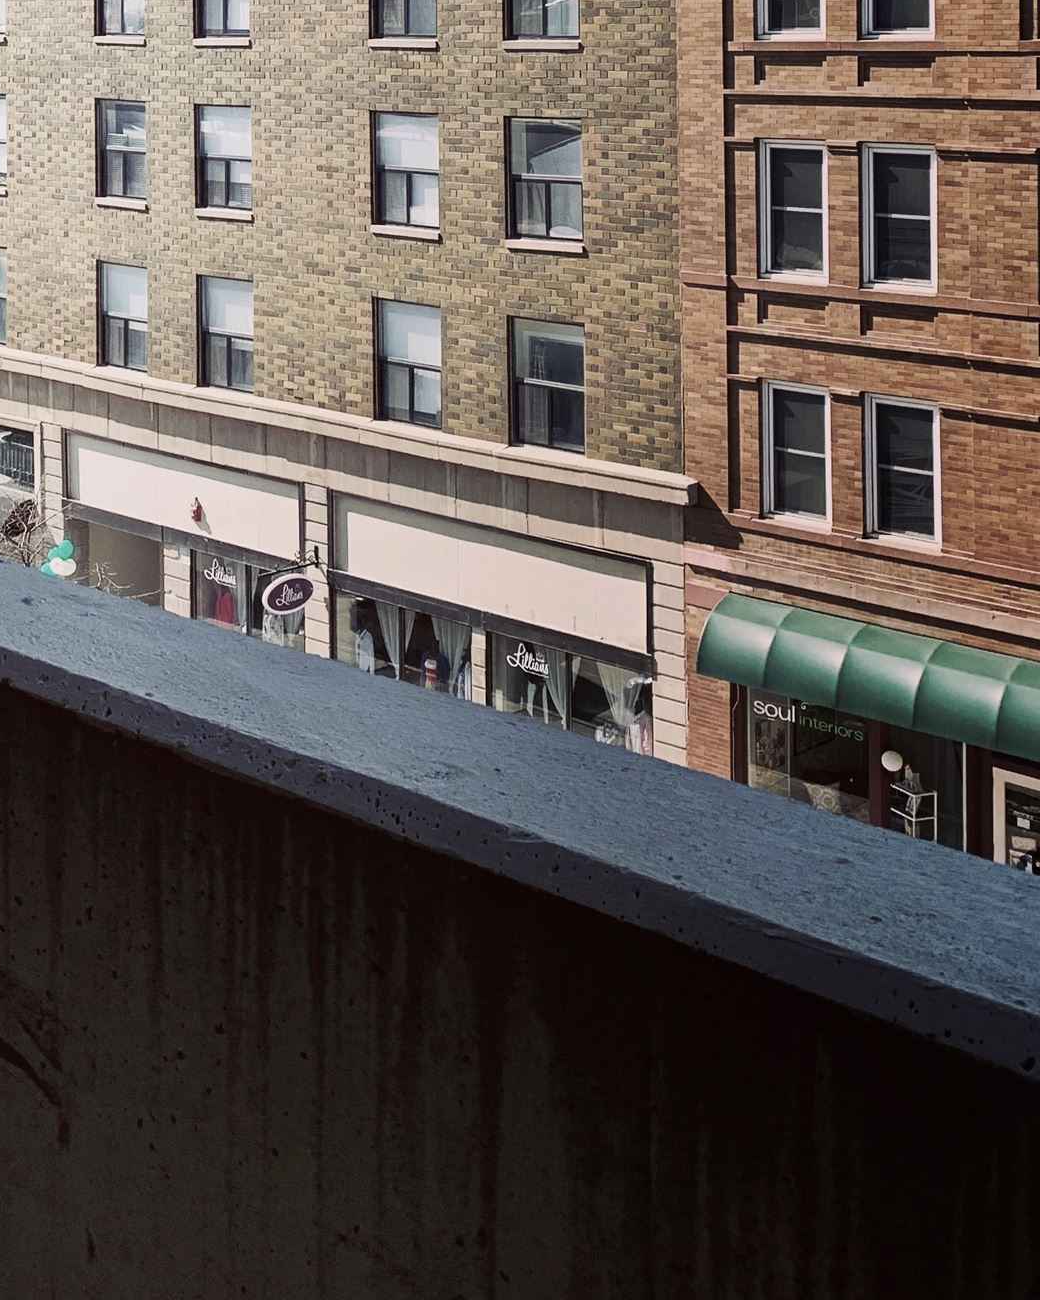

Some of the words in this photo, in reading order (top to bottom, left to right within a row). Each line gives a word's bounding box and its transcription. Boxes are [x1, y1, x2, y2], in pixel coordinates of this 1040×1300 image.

[506, 642, 550, 678] Lillians
[753, 700, 796, 723] soul
[799, 713, 865, 742] interiors
